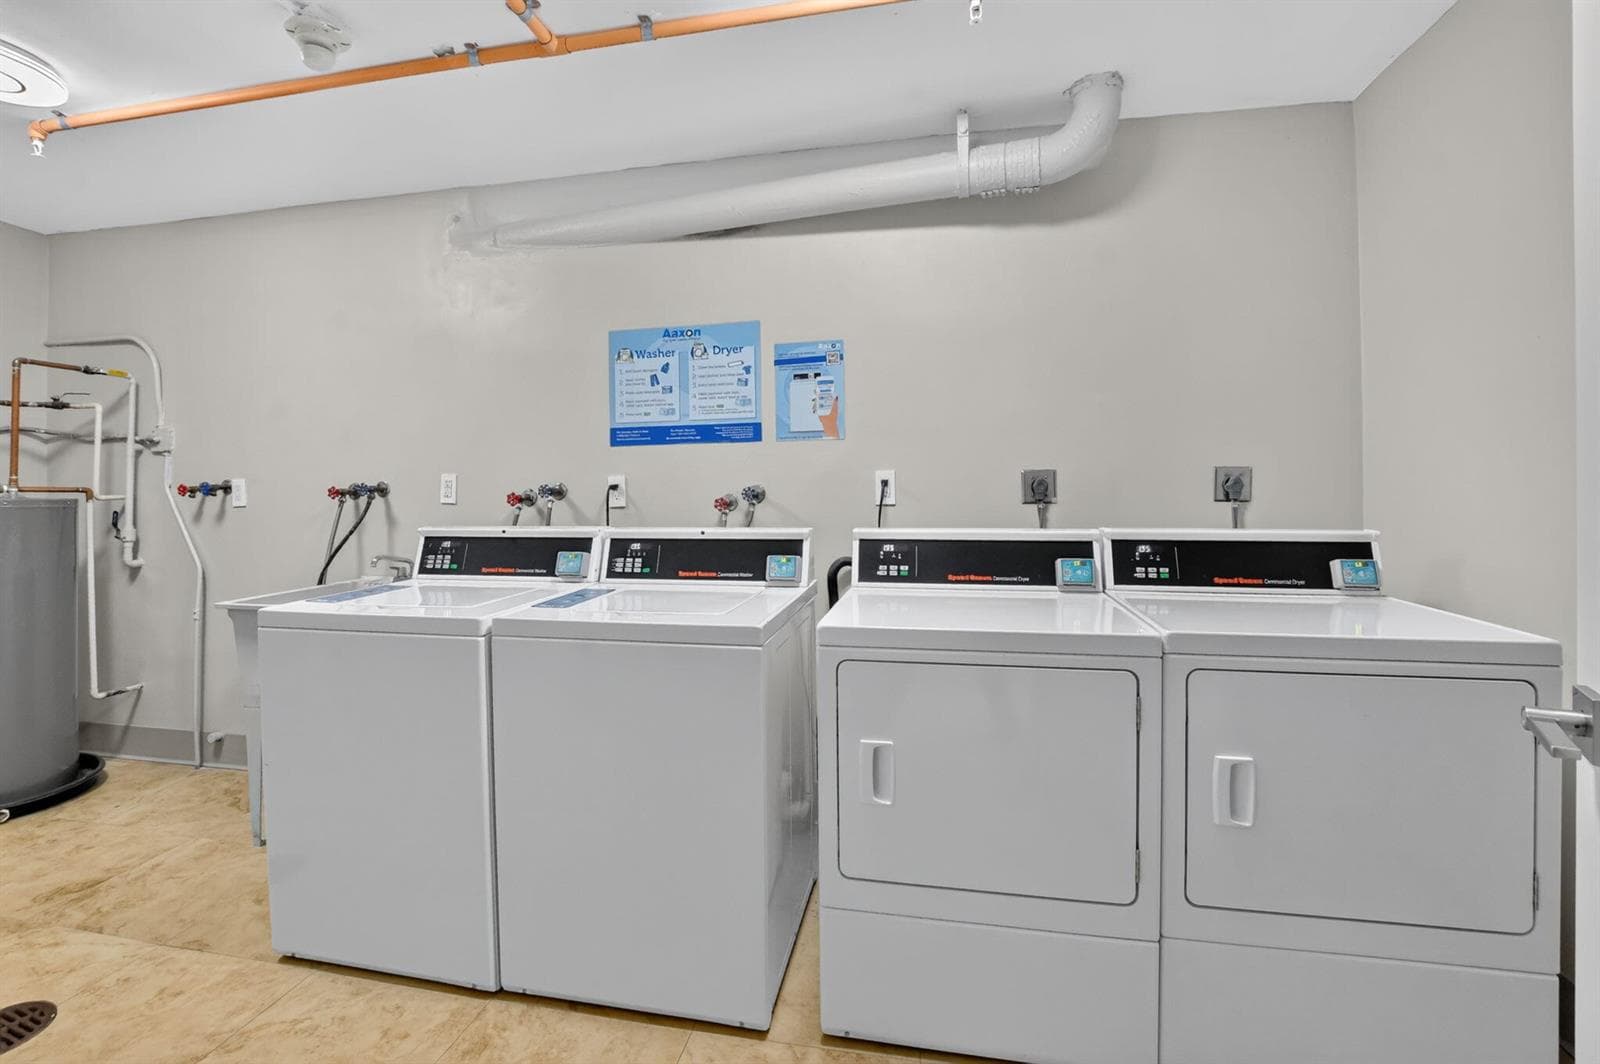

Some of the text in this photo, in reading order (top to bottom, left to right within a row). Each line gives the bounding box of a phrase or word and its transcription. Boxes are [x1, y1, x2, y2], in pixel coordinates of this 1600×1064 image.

[662, 328, 702, 338] Aaxon
[635, 348, 676, 359] Washer
[712, 345, 744, 357] Dryer
